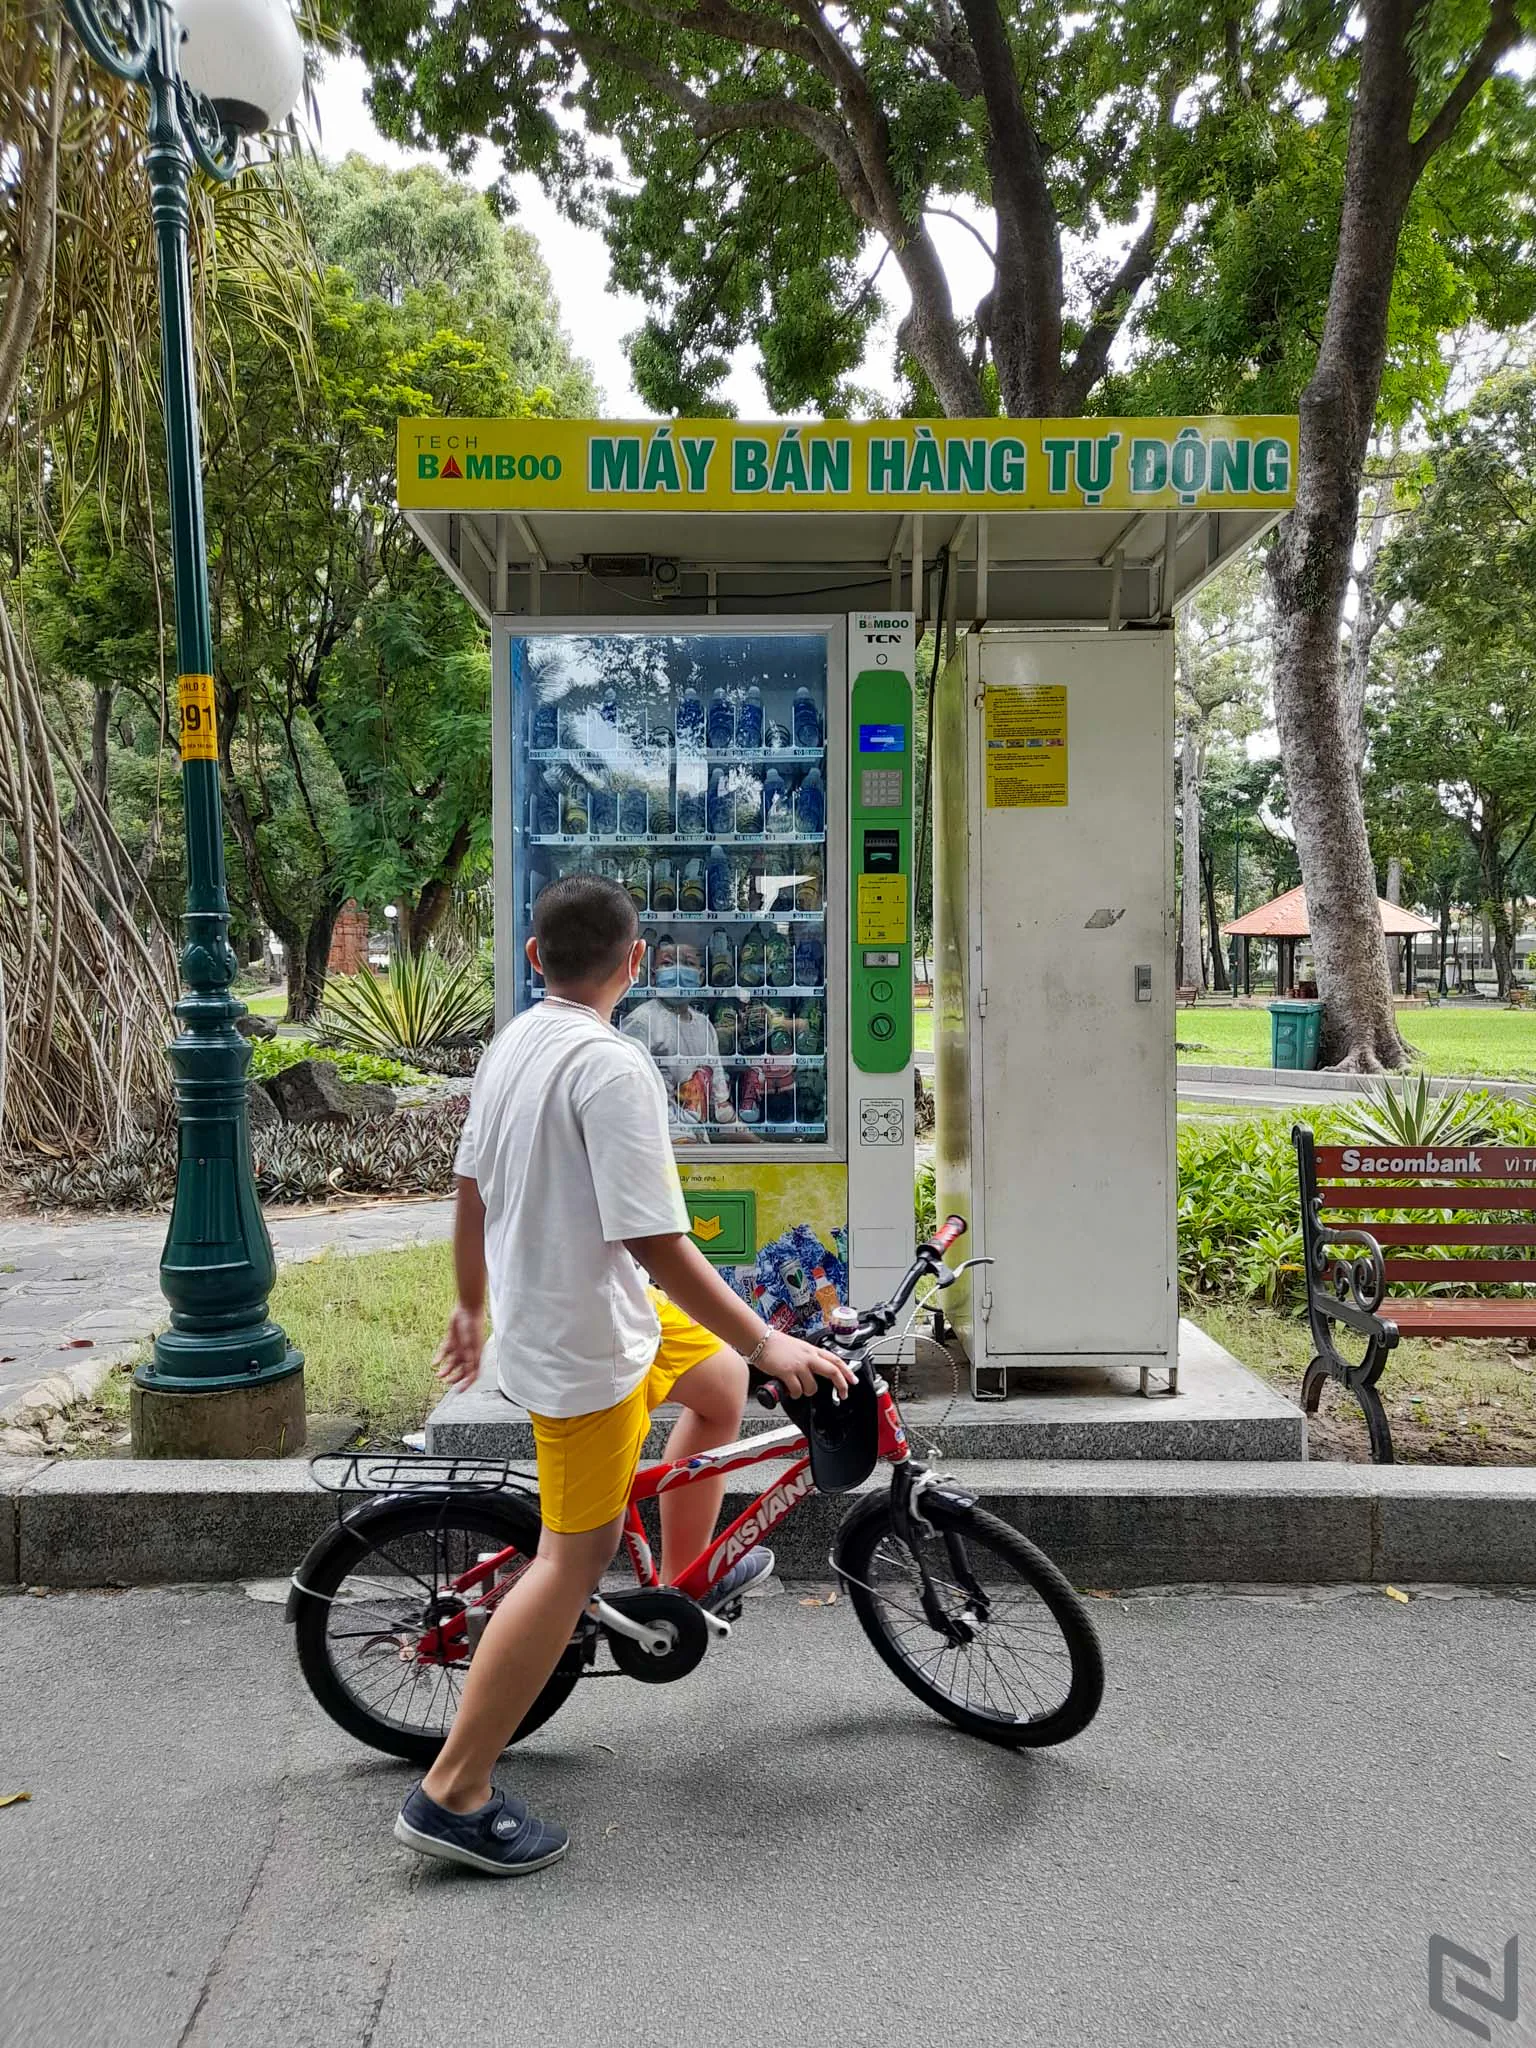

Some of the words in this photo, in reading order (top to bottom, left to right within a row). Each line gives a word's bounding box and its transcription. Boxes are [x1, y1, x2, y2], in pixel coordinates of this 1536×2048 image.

[414, 435, 478, 449] TECH
[588, 427, 715, 494] MÁY
[731, 427, 852, 494] BÁN
[868, 427, 1027, 494] HÀNG
[1041, 431, 1122, 505] TỰ
[1128, 427, 1291, 505] ĐỘNG
[863, 634, 902, 643] TCN
[1341, 1149, 1483, 1174] Sacombank
[1504, 1156, 1520, 1172] VÌ
